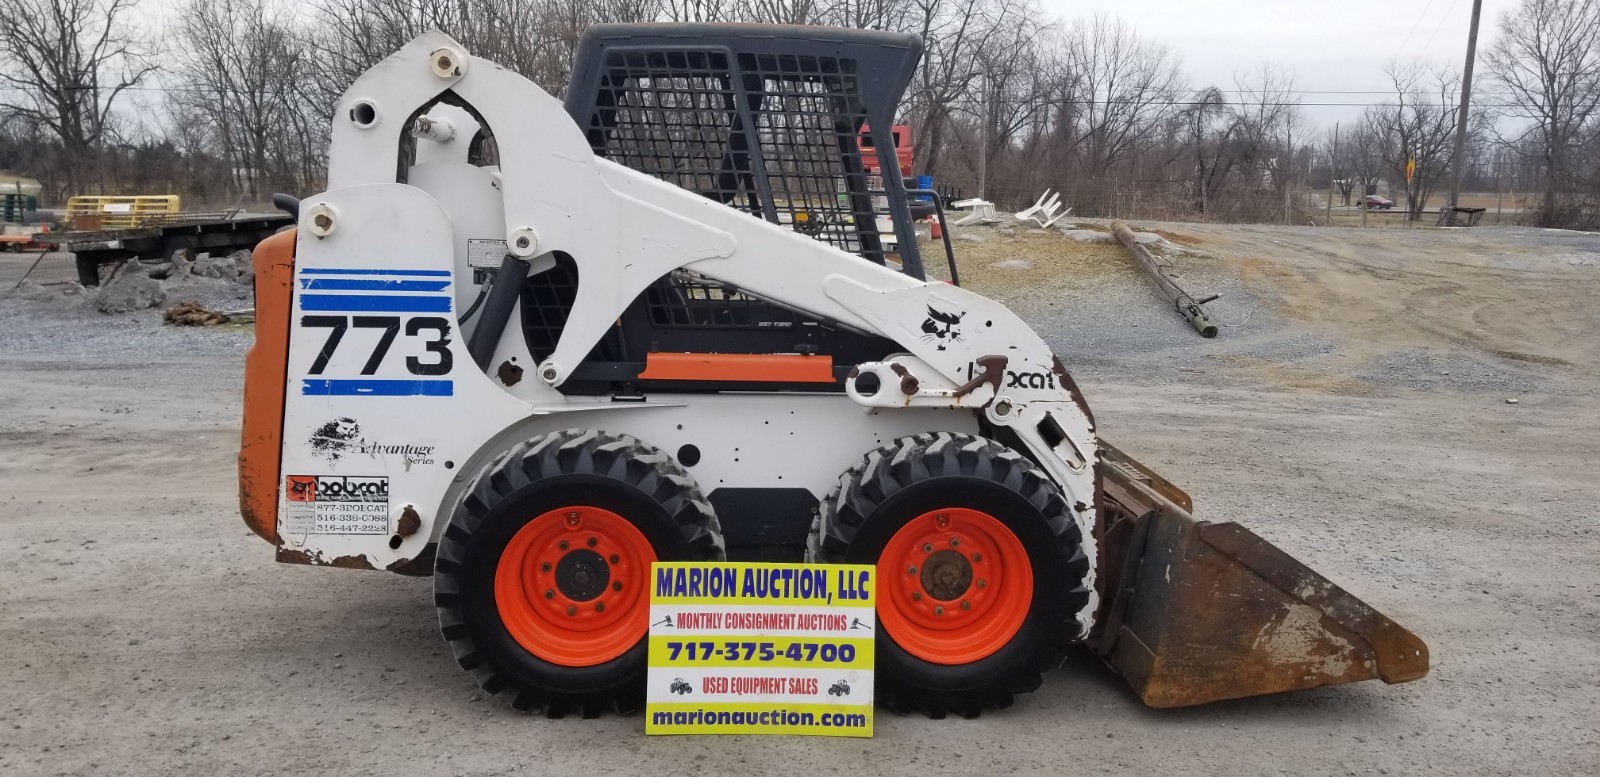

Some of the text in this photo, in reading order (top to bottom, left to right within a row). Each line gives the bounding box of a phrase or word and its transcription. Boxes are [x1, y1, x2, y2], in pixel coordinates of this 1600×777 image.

[301, 315, 453, 376] 773
[350, 437, 435, 458] Advantage
[407, 456, 435, 465] Series
[315, 476, 388, 495] bobcat
[656, 567, 870, 605] MARION AUCTION, LLC
[677, 612, 847, 631] MONTHLY CONSIGNMENT AUCTIONS
[667, 642, 856, 663] 717-375-4700
[702, 677, 818, 695] USED EQUIPMENT SALES
[653, 709, 866, 727] marionauction.com
